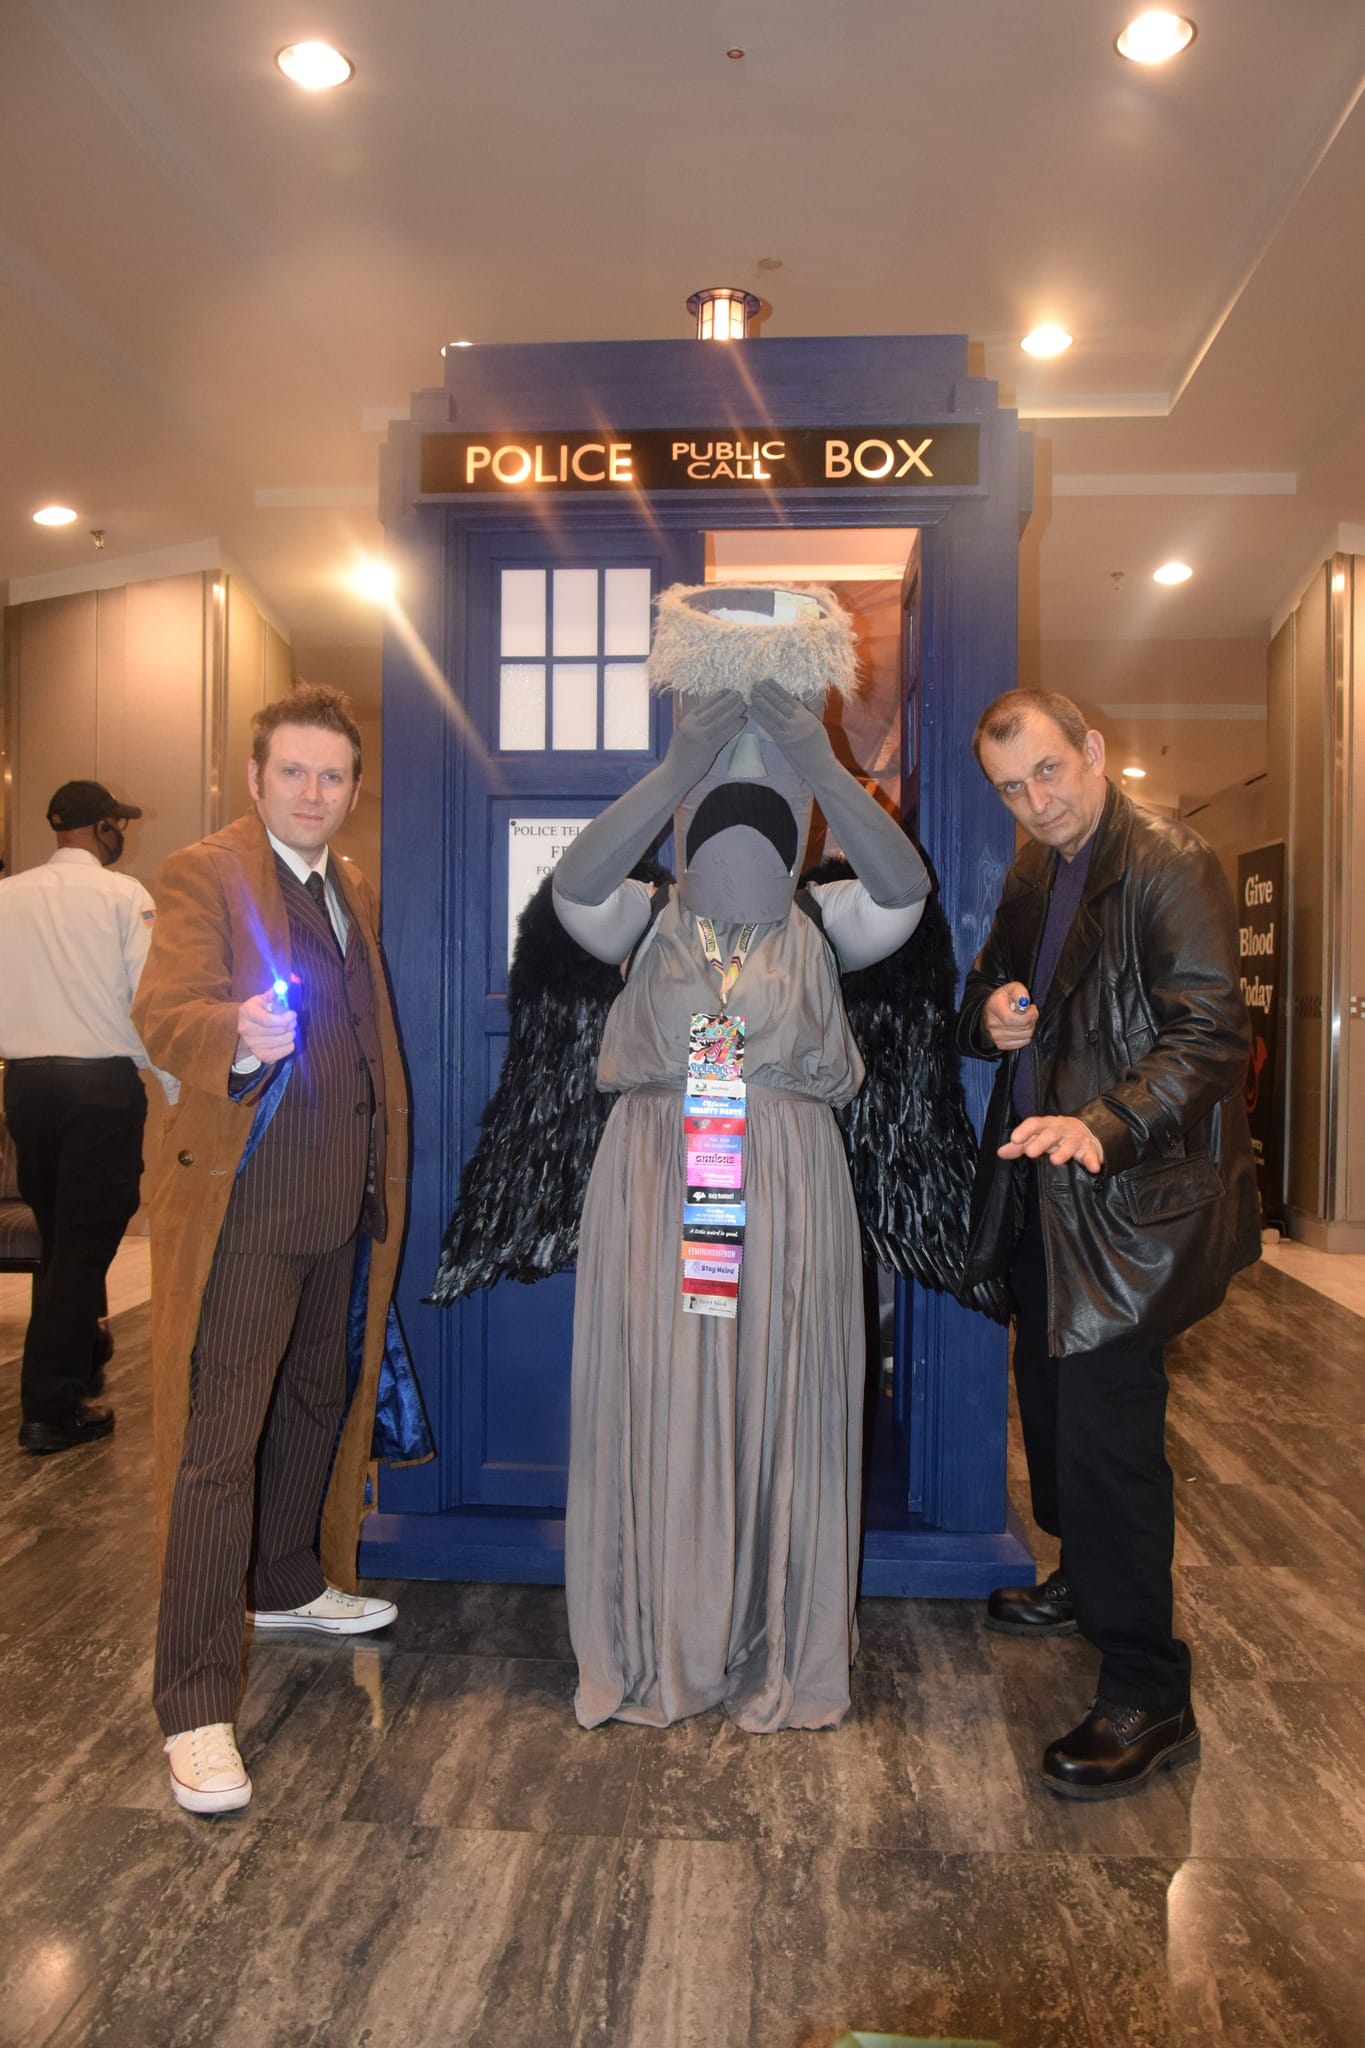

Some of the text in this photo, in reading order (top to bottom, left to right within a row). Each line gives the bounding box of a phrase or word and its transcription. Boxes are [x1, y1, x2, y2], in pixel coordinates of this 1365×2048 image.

[466, 443, 633, 484] POLICE
[671, 441, 785, 461] PUBLIC
[825, 438, 934, 479] BOX
[687, 461, 772, 480] CALL
[513, 826, 581, 836] POLICE TEL
[1245, 873, 1273, 907] Give
[1239, 922, 1275, 957] Blood
